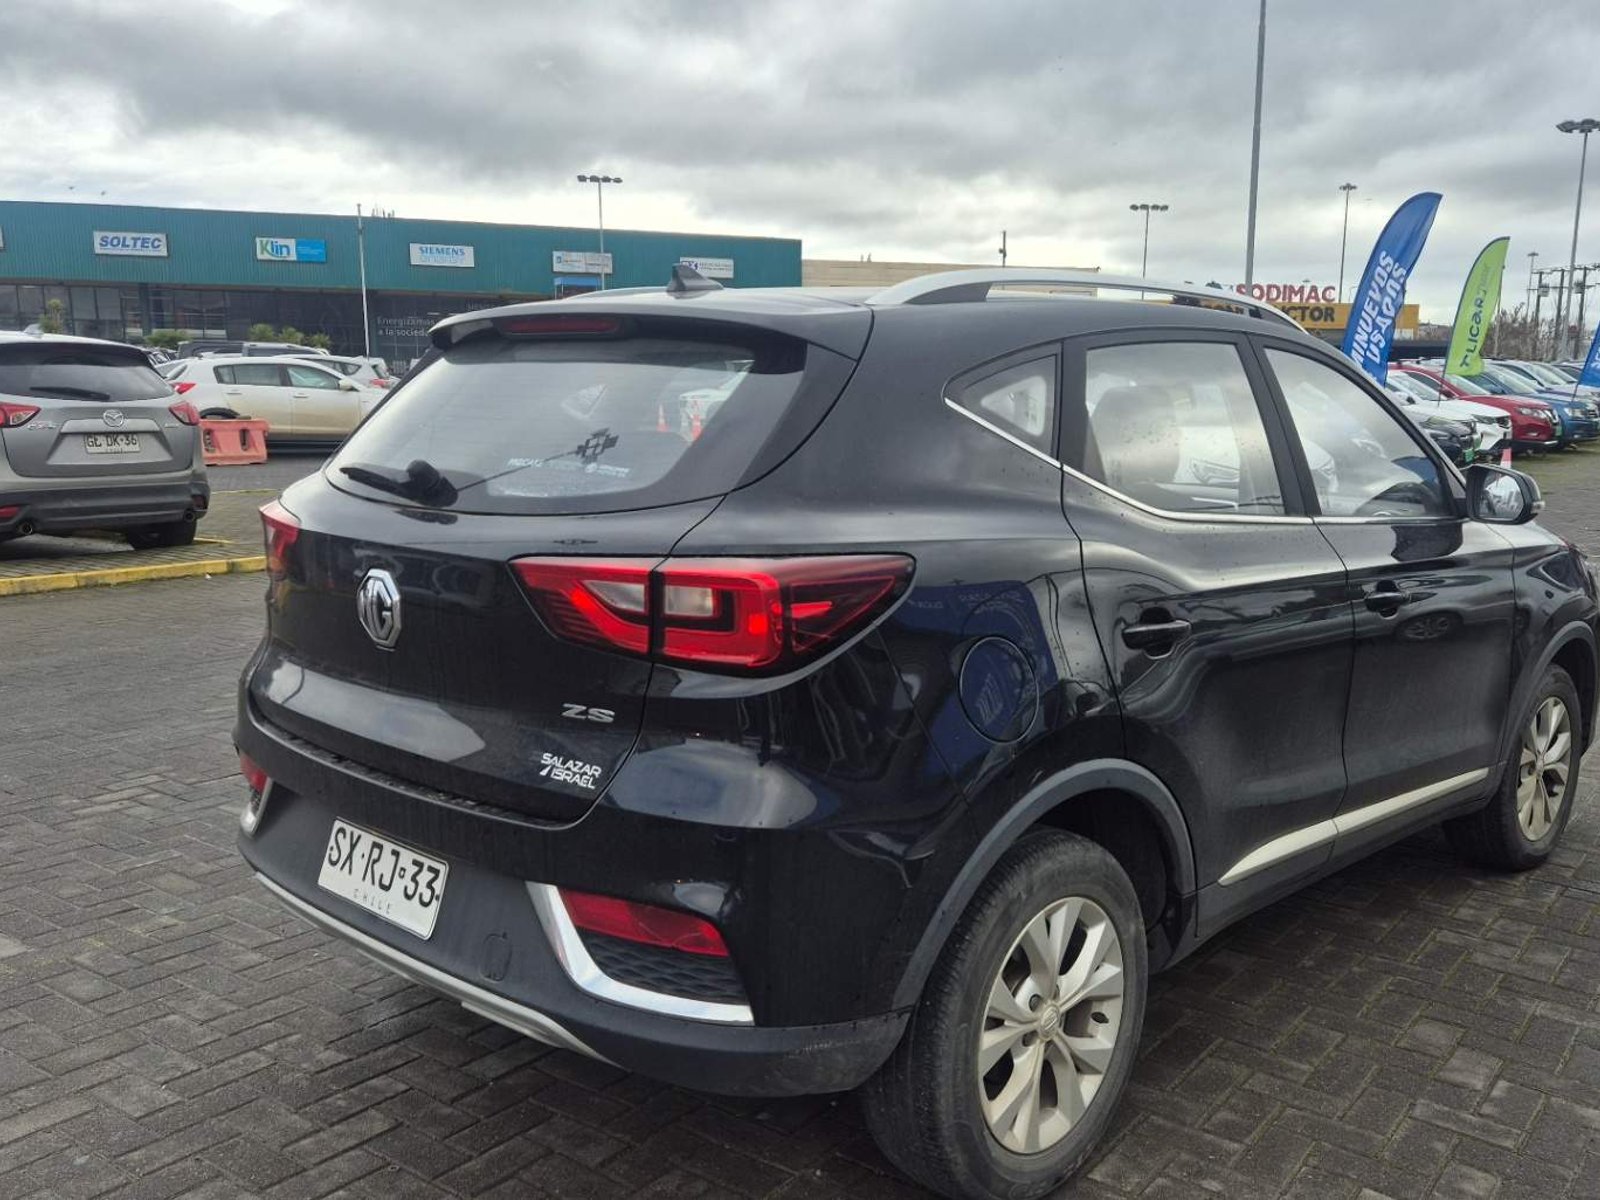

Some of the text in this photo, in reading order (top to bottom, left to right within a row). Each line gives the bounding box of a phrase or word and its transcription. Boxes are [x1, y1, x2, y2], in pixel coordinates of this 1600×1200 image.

[99, 235, 162, 249] SOLTEC
[259, 239, 291, 258] Klin
[419, 246, 466, 257] SIEMENS
[1236, 283, 1336, 303] SODIMAC
[561, 703, 616, 723] ZS
[540, 752, 602, 778] SALAZAR
[550, 767, 597, 789] ISRAEL
